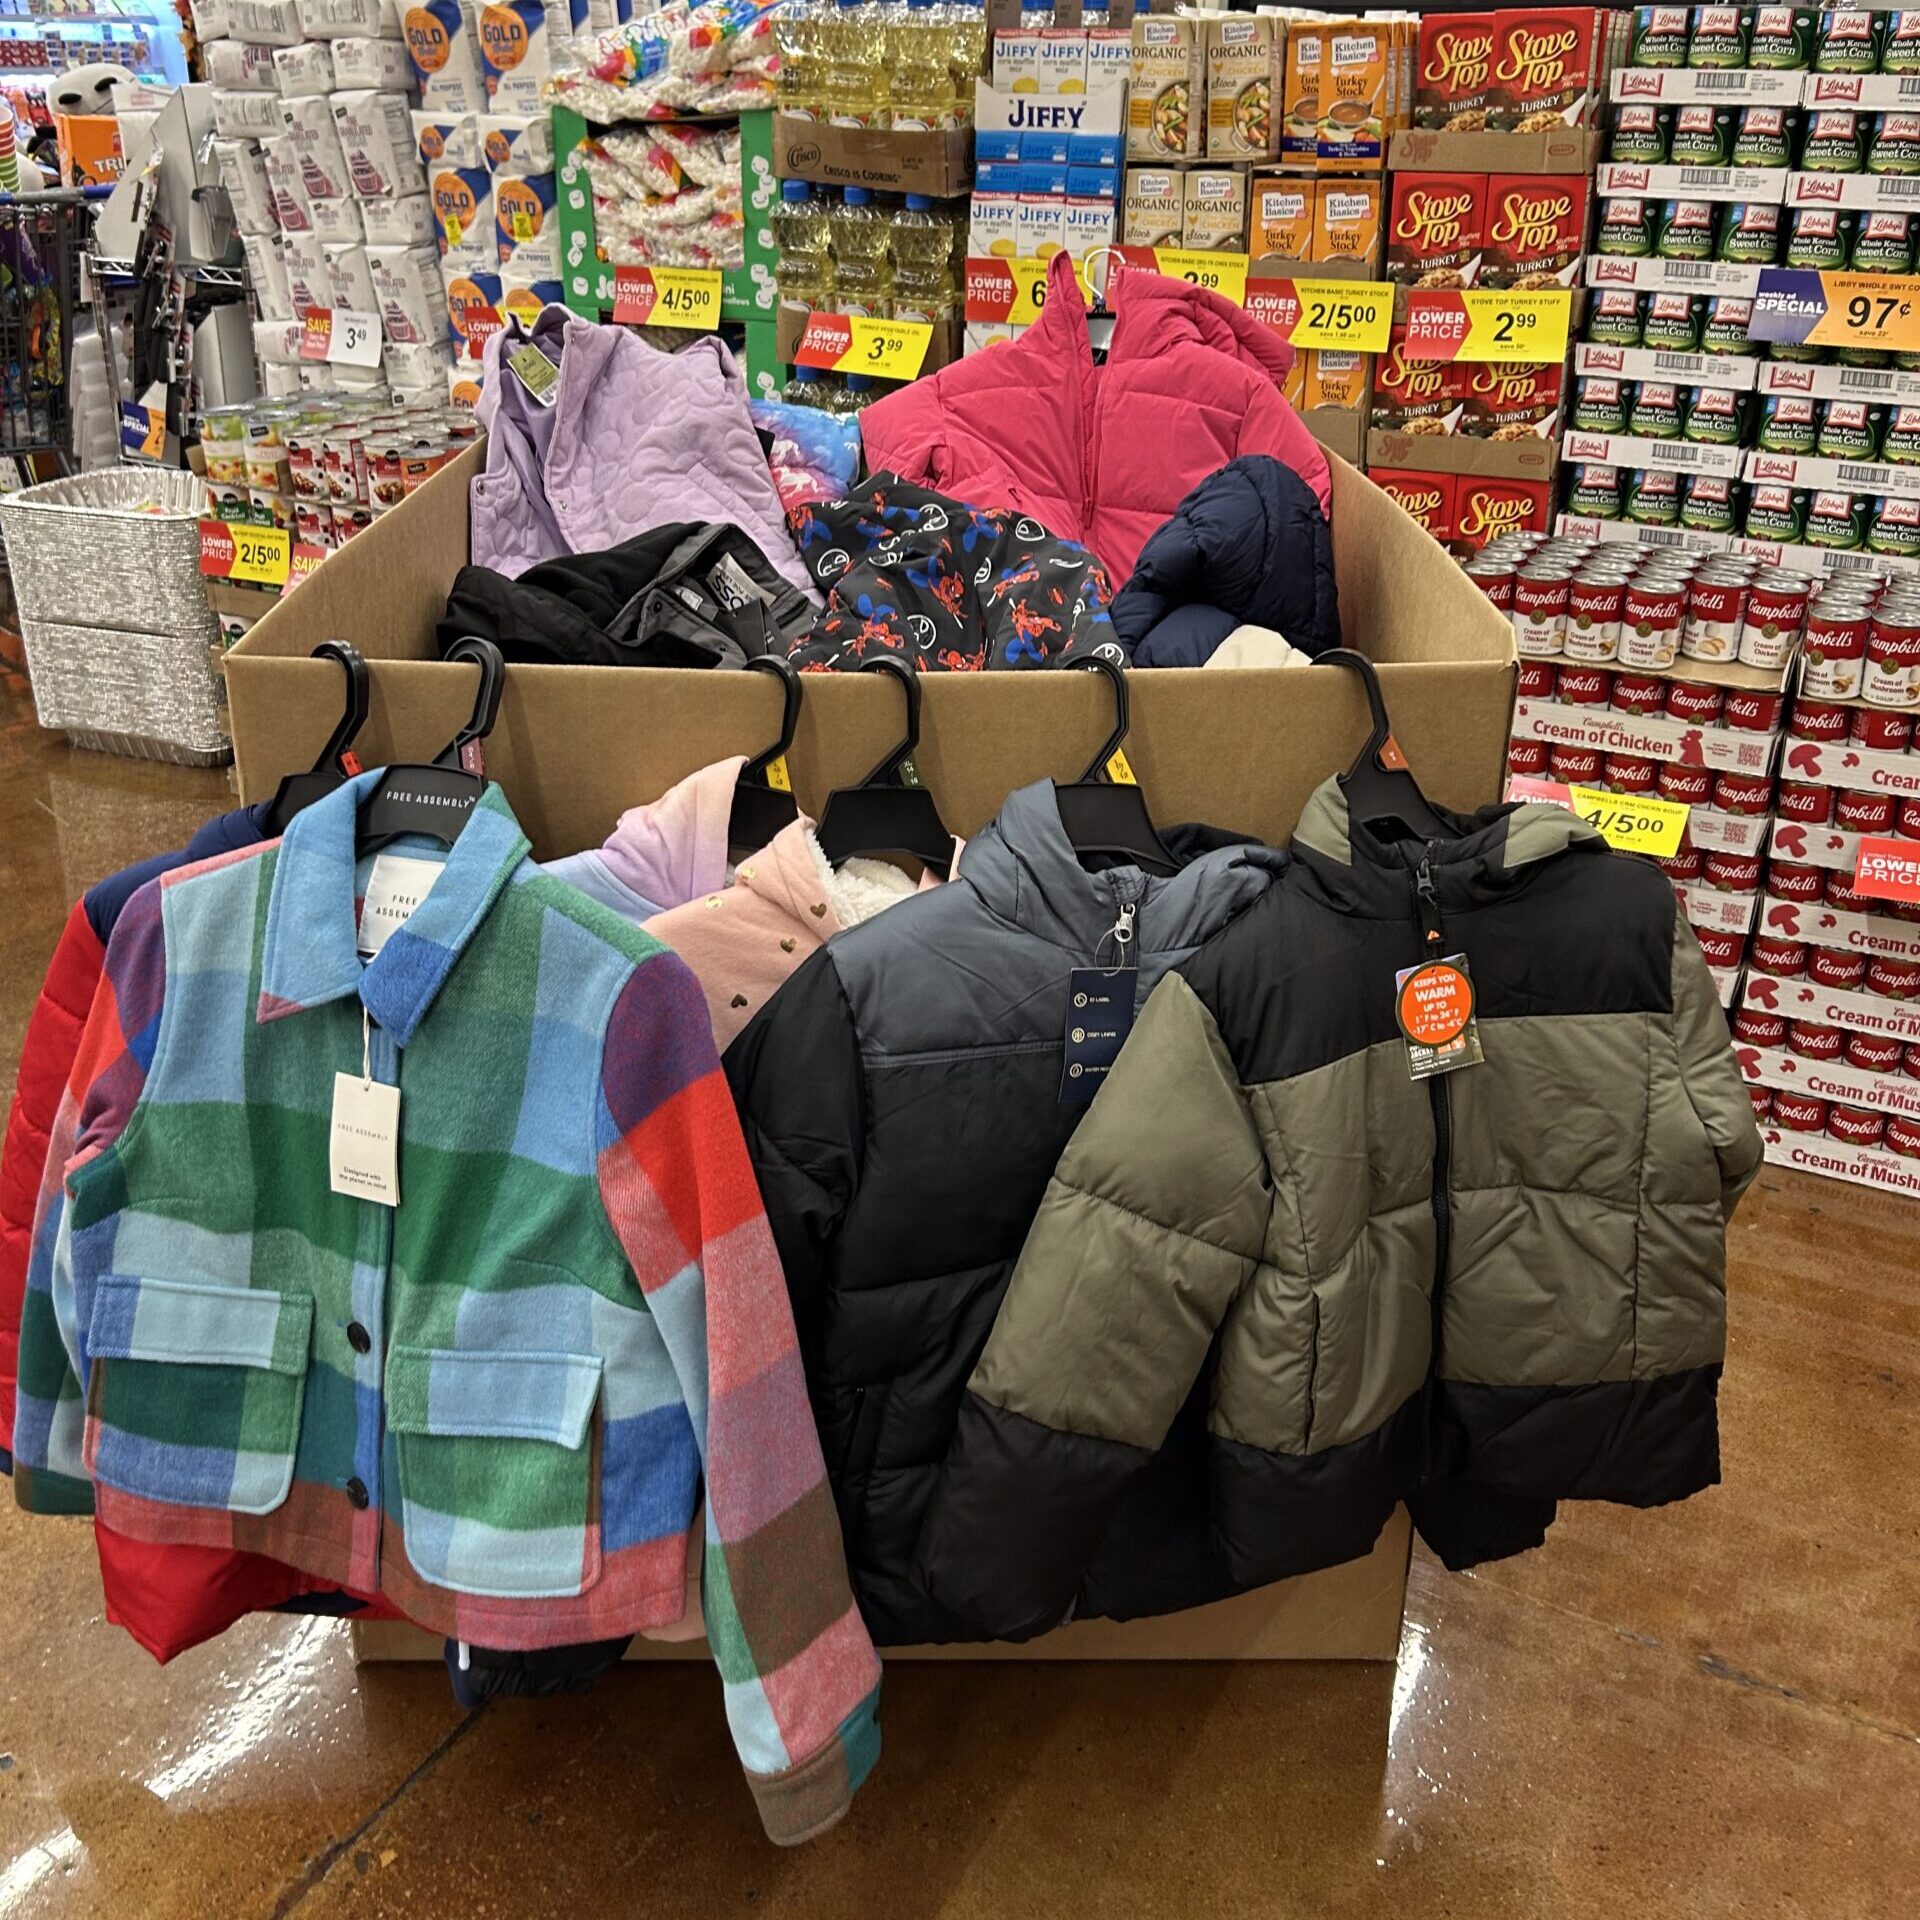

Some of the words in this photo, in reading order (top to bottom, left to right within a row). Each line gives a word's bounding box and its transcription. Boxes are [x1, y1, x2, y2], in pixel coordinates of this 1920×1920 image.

[1838, 15, 1866, 31] Libby's
[408, 28, 442, 46] GOLD
[483, 24, 521, 43] GOLD
[1714, 35, 1739, 44] Kernel
[995, 42, 1037, 58] JIFFY
[1042, 43, 1084, 58] JIFFY
[1090, 43, 1131, 59] JIFFY
[1335, 41, 1375, 52] Kitchen
[1715, 43, 1741, 54] Corn
[1847, 40, 1872, 49] Kernel
[1132, 46, 1187, 60] ORGANIC
[1210, 45, 1266, 59] ORGANIC
[1335, 52, 1367, 62] Basics
[1496, 29, 1579, 81] Stove
[1819, 49, 1847, 59] Sweet
[1848, 48, 1874, 60] Corn
[1449, 64, 1490, 94] Top
[1521, 60, 1565, 93] Top
[1336, 85, 1366, 97] Stock
[1825, 79, 1854, 93] Libby's
[1520, 95, 1561, 113] TURKEY
[1823, 118, 1850, 132] Libby's
[1809, 140, 1830, 148] Whole
[1831, 139, 1856, 148] Kernel
[1805, 148, 1832, 158] Sweet
[1832, 147, 1858, 159] Corn
[1806, 180, 1836, 192] Libby's
[436, 189, 468, 209] GOLD
[500, 196, 536, 216] GOLD
[1126, 198, 1180, 212] ORGANIC
[1265, 198, 1302, 208] Kitchen
[1329, 198, 1368, 209] Kitchen
[973, 203, 1014, 220] JIFFY
[1186, 200, 1242, 213] ORGANIC
[1265, 207, 1295, 216] Basics
[1329, 208, 1361, 217] Basics
[1019, 206, 1062, 223] JIFFY
[1067, 209, 1111, 226] JIFFY
[1396, 190, 1474, 239] Stove
[1490, 193, 1572, 242] Stove
[1265, 229, 1297, 243] Turkey
[1420, 221, 1461, 250] Top
[1669, 227, 1690, 235] Whole
[1266, 240, 1293, 250] Stock
[1331, 240, 1359, 251] Stock
[1516, 223, 1558, 254] Top
[1663, 235, 1692, 245] Sweet
[1420, 254, 1458, 270] TURKEY
[1515, 257, 1555, 274] TURKEY
[617, 282, 654, 294] LOWER
[967, 276, 1013, 289] LOWER
[1834, 280, 1857, 288] LIBBY
[1858, 281, 1887, 290] WHOLE
[1889, 282, 1906, 290] SWT
[967, 289, 1012, 304] PRICE
[1301, 287, 1326, 295] KITCHEN
[1345, 289, 1369, 297] TURKEY
[1758, 291, 1785, 299] weekly
[1786, 292, 1797, 300] ad
[616, 293, 653, 306] PRICE
[1247, 296, 1297, 311] LOWER
[1755, 299, 1825, 315] SPECIAL
[1846, 295, 1913, 330] 97¢
[1410, 311, 1466, 325] LOWER
[307, 317, 331, 334] SAVE
[1409, 324, 1463, 339] PRICE
[807, 328, 850, 344] LOWER
[802, 339, 846, 355] PRICE
[1321, 358, 1351, 368] Basics
[1404, 370, 1443, 399] Top
[1321, 389, 1348, 401] Stock
[1403, 404, 1440, 418] TURKEY
[1495, 409, 1533, 424] TURKEY
[1713, 413, 1735, 423] Kernel
[1688, 418, 1714, 429] Sweet
[1714, 420, 1737, 431] Corn
[202, 536, 233, 550] LOWER
[202, 547, 233, 561] PRICE
[1625, 596, 1678, 620] Campbell's
[1748, 597, 1802, 620] Campbell's
[1524, 635, 1548, 643] Chicken
[1629, 648, 1653, 657] Chicken
[1754, 649, 1779, 658] Chicken
[1870, 682, 1905, 695] Mushroom
[1582, 716, 1625, 732] Campbell's
[1532, 719, 1586, 742] Cream
[1588, 730, 1606, 745] of
[1607, 729, 1673, 756] Chicken
[386, 790, 412, 803] FREE
[1716, 779, 1770, 803] Campbell's
[1619, 799, 1635, 808] CRM
[1661, 806, 1684, 816] SOUP
[1861, 857, 1920, 874] LOWE
[392, 894, 418, 906] FREE
[375, 906, 409, 919] ASSEM
[1848, 929, 1907, 954] Cream
[1413, 976, 1437, 989] KEEPS
[1438, 973, 1456, 984] YOU
[1415, 985, 1456, 1002] WARM
[1423, 1003, 1435, 1012] UP
[1435, 1002, 1447, 1010] TO
[1826, 1005, 1884, 1029] Cream
[1886, 1018, 1906, 1033] of
[1807, 1076, 1864, 1102] Cream
[1866, 1089, 1886, 1105] of
[1791, 1148, 1847, 1173] Cream
[1849, 1161, 1869, 1177] of
[1857, 1151, 1902, 1171] Campbell's
[343, 1165, 369, 1178] Designed
[369, 1173, 382, 1181] with
[338, 1173, 348, 1181] the
[349, 1175, 366, 1186] planet
[373, 1181, 387, 1190] mind
